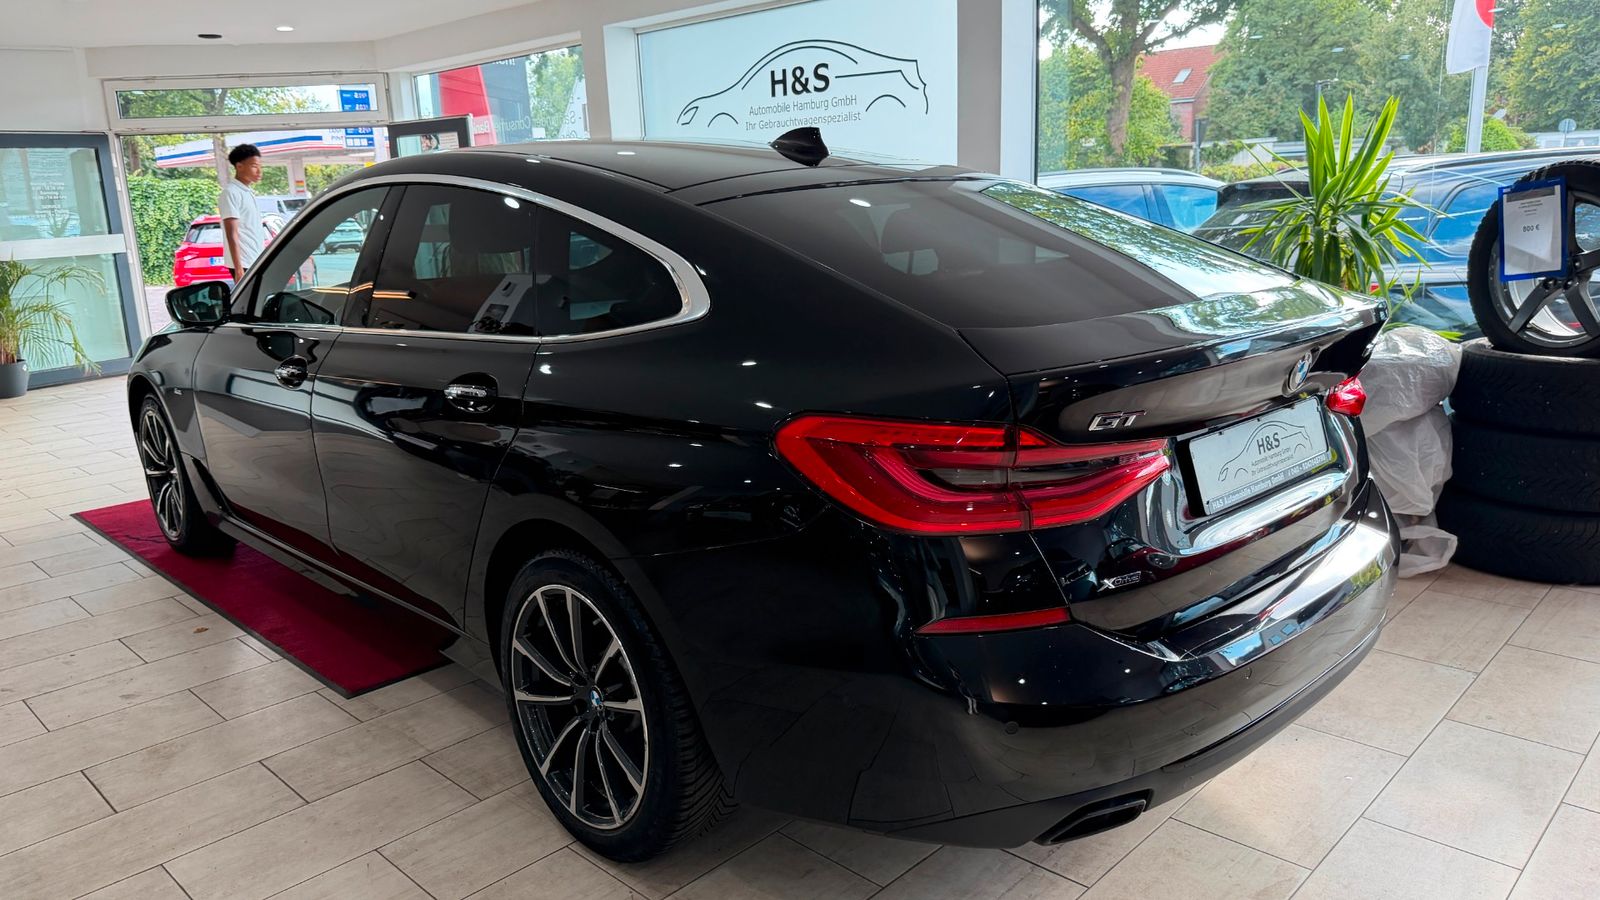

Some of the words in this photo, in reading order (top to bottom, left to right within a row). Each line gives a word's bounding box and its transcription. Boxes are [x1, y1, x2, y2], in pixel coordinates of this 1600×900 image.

[770, 62, 831, 97] H&S
[749, 101, 791, 117] Automobile
[792, 98, 829, 111] Hamburg
[831, 94, 857, 107] GmbH
[745, 121, 757, 131] Ihr
[758, 111, 862, 129] Gebrauchtwagenspezialist
[1089, 410, 1147, 431] GT
[1256, 432, 1281, 455] H&S
